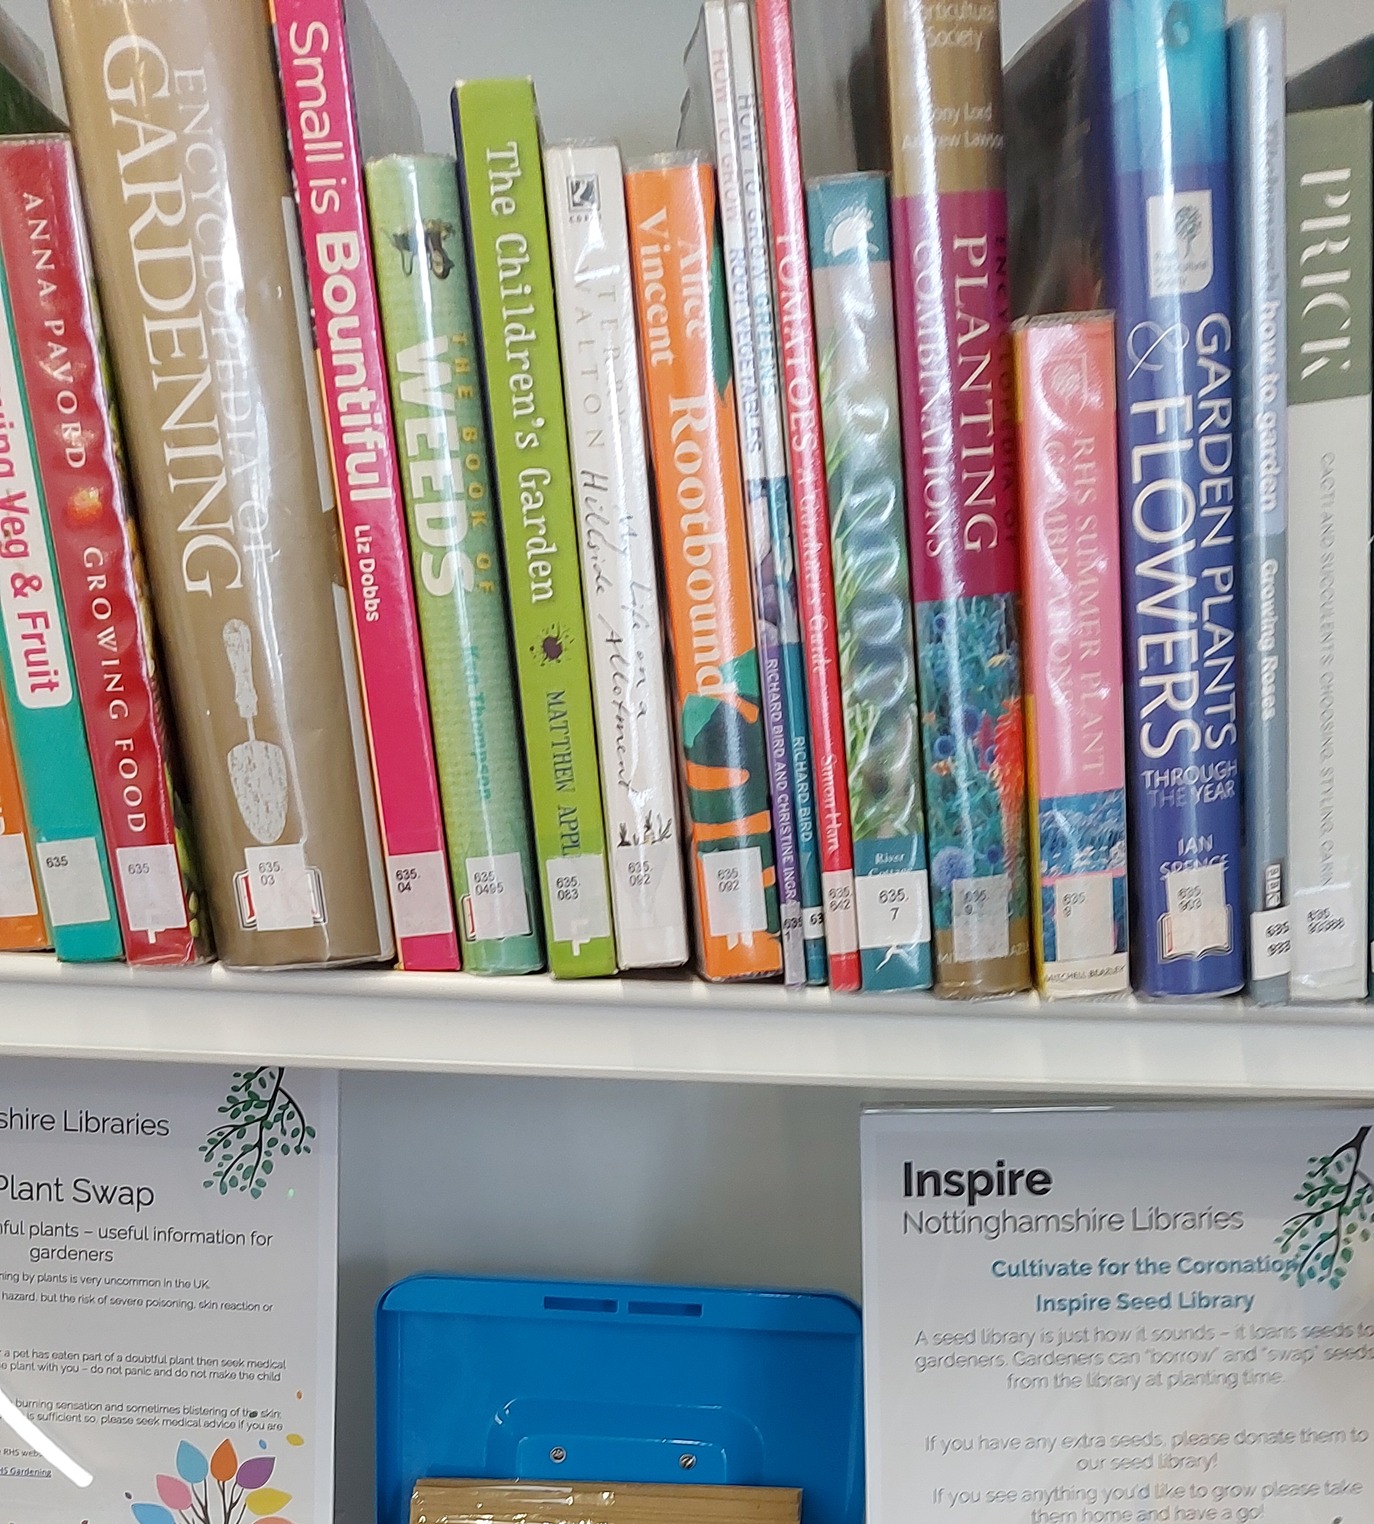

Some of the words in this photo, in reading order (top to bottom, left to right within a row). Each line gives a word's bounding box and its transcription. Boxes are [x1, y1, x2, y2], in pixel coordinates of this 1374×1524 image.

[289, 20, 345, 163] Small
[308, 177, 348, 214] is
[485, 141, 523, 217] The
[22, 191, 58, 298] ANNA
[1301, 167, 1352, 381] PRICK
[102, 34, 244, 597] GARDENING
[638, 207, 675, 368] Vincent
[315, 230, 391, 501] Bountiful
[450, 331, 473, 399] THE
[495, 232, 545, 451] Children's
[1126, 320, 1190, 381] &
[38, 317, 87, 470] PAVORD
[952, 234, 998, 553] PLANTING
[1195, 312, 1235, 548] GARDEN
[395, 334, 475, 597] WEEDS
[461, 426, 486, 527] BOOK
[353, 524, 372, 553] Liz
[518, 467, 555, 604] Garden
[668, 393, 727, 696] Rootbound
[9, 572, 44, 599] &
[357, 557, 380, 622] Dobbs
[1131, 394, 1201, 759] FLOWERS
[16, 610, 60, 694] Fruit
[82, 546, 129, 720] GROWING
[1200, 564, 1239, 750] PLANTS
[547, 690, 575, 793] MATTHEW
[114, 737, 148, 834] FOOD
[1141, 761, 1239, 790] THROUGH
[1194, 780, 1236, 804] YEAR
[45, 854, 69, 869] 635
[127, 861, 150, 875] 635
[257, 861, 284, 874] 635.
[1177, 834, 1214, 855] IAN
[259, 874, 276, 886] 03
[890, 907, 900, 921] 7
[63, 1108, 170, 1137] Libraries
[72, 1177, 155, 1213] Swap
[902, 1159, 1054, 1206] Inspire
[29, 1222, 79, 1245] plants
[98, 1225, 149, 1242] useful
[153, 1227, 246, 1246] information
[250, 1229, 273, 1247] for
[29, 1245, 114, 1264] gardeners
[902, 1209, 1125, 1240] Nottinghamshire
[1131, 1206, 1246, 1232] Libraries
[992, 1259, 1094, 1279] Cultivate
[1099, 1258, 1132, 1277] for
[1136, 1257, 1172, 1275] the
[1177, 1254, 1300, 1275] Coronation
[1036, 1293, 1111, 1317] Inspire
[1116, 1291, 1172, 1311] Seed
[1178, 1291, 1256, 1314] Library
[941, 1439, 973, 1456] you
[978, 1435, 1021, 1450] have
[1025, 1436, 1057, 1453] any
[1062, 1434, 1105, 1449] extra
[1170, 1432, 1230, 1450] please
[1233, 1429, 1295, 1446] donate
[1300, 1428, 1346, 1443] them
[1351, 1428, 1369, 1442] to
[1076, 1457, 1106, 1471] our
[1110, 1456, 1153, 1469] seed
